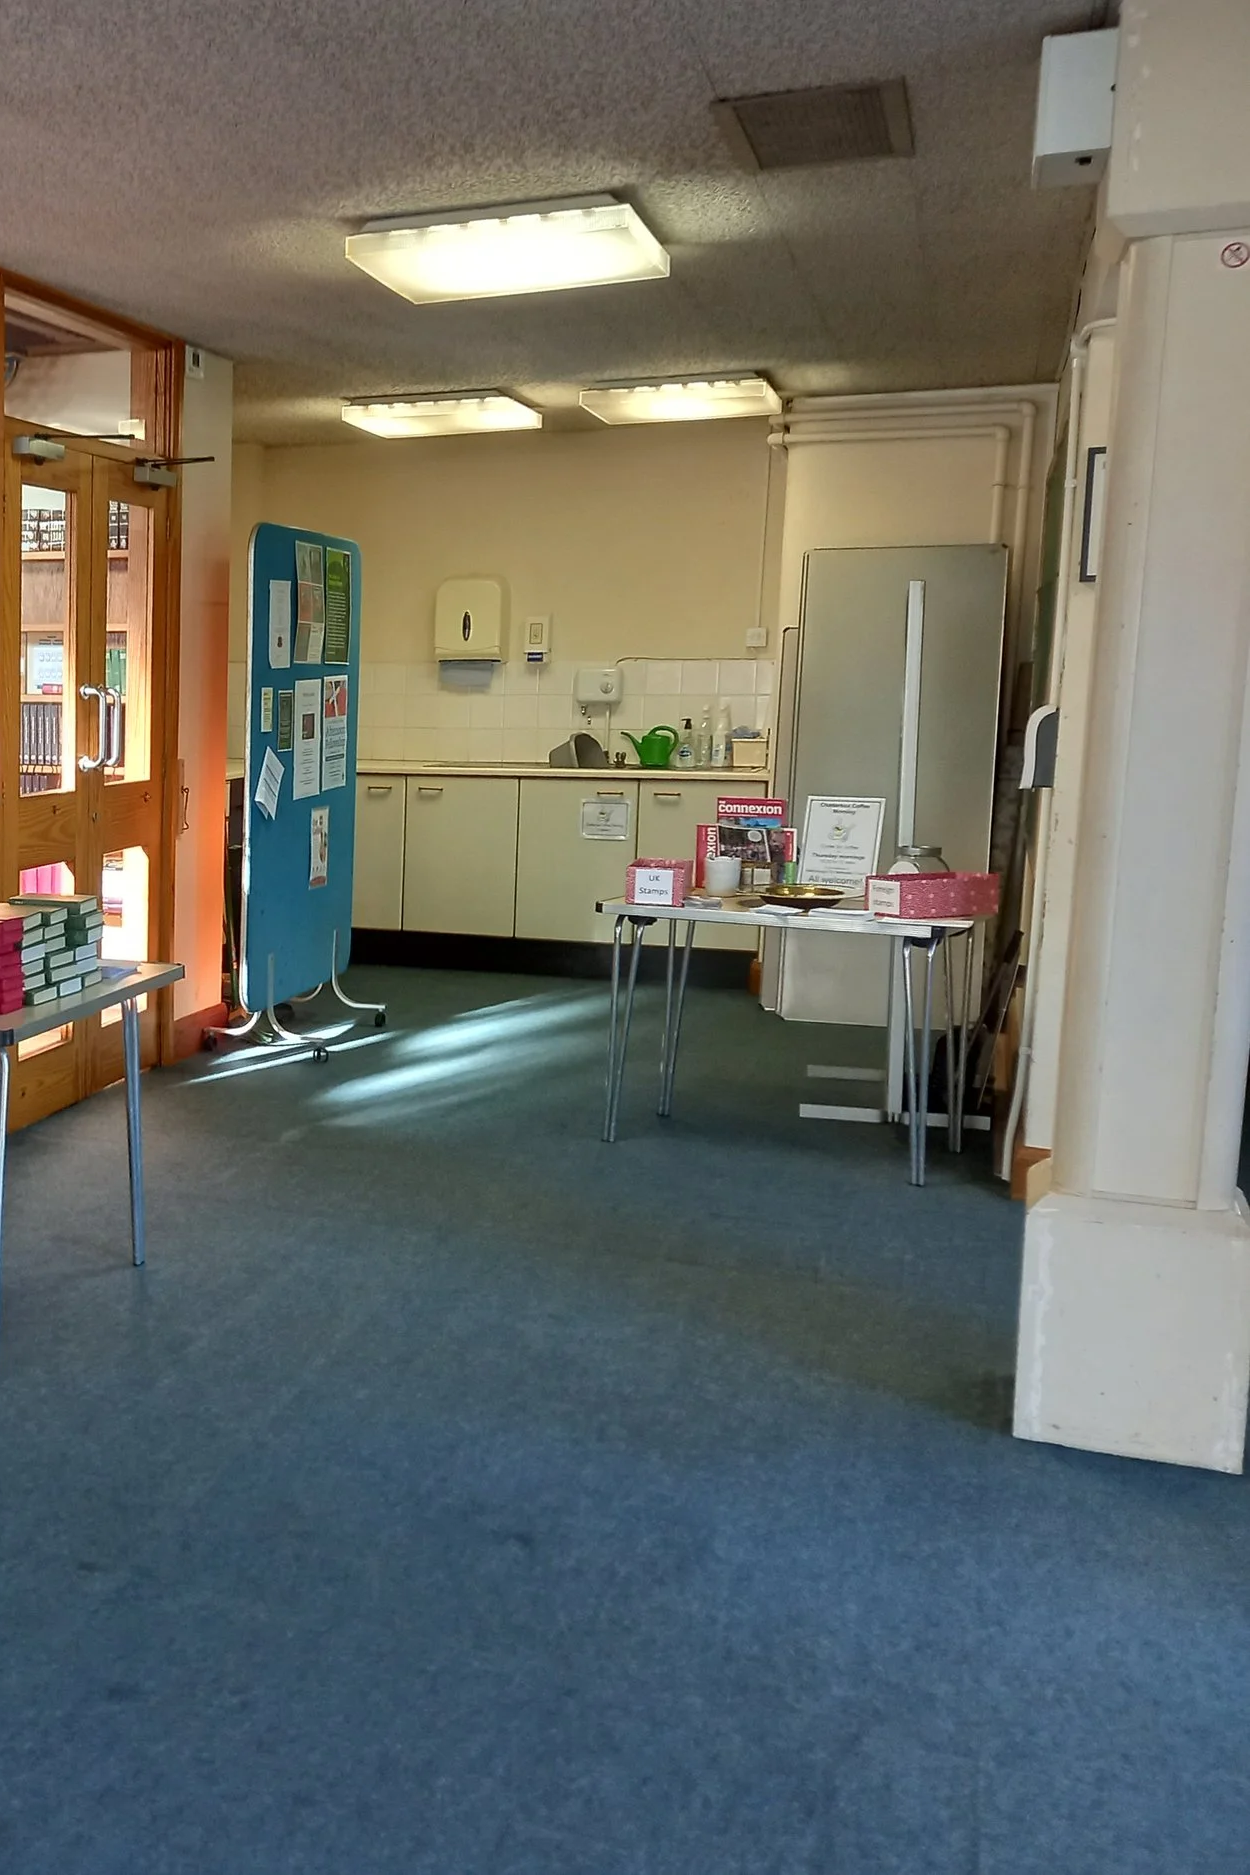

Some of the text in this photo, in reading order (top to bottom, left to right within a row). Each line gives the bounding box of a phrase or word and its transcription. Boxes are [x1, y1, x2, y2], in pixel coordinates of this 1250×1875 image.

[718, 804, 783, 815] connexion
[648, 874, 661, 882] UK
[808, 875, 820, 883] All
[638, 886, 669, 897] Stamps
